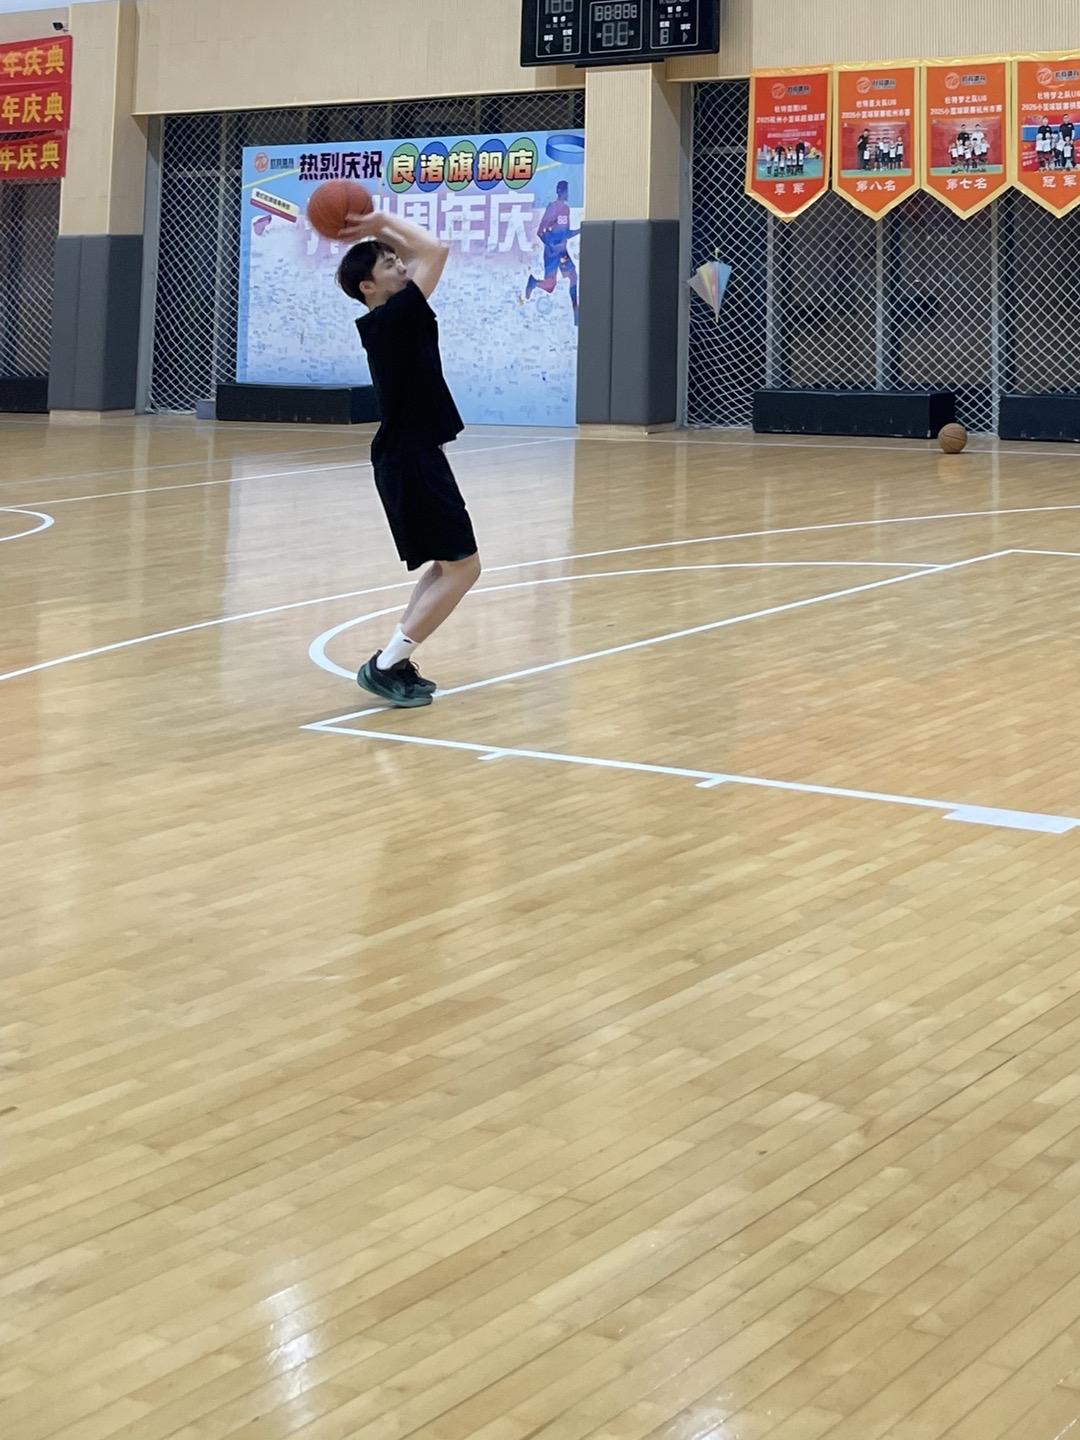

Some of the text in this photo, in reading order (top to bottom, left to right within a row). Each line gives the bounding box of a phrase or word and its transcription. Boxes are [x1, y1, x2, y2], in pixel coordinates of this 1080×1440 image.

[0, 44, 64, 78] 年庆典
[2, 92, 64, 124] 年庆典
[0, 140, 60, 171] 年庆典
[299, 148, 535, 185] 热烈庆祝 良渚旗舰店
[856, 180, 896, 193] 第八名
[946, 178, 987, 190] 第七名
[1042, 175, 1077, 188] 冠军
